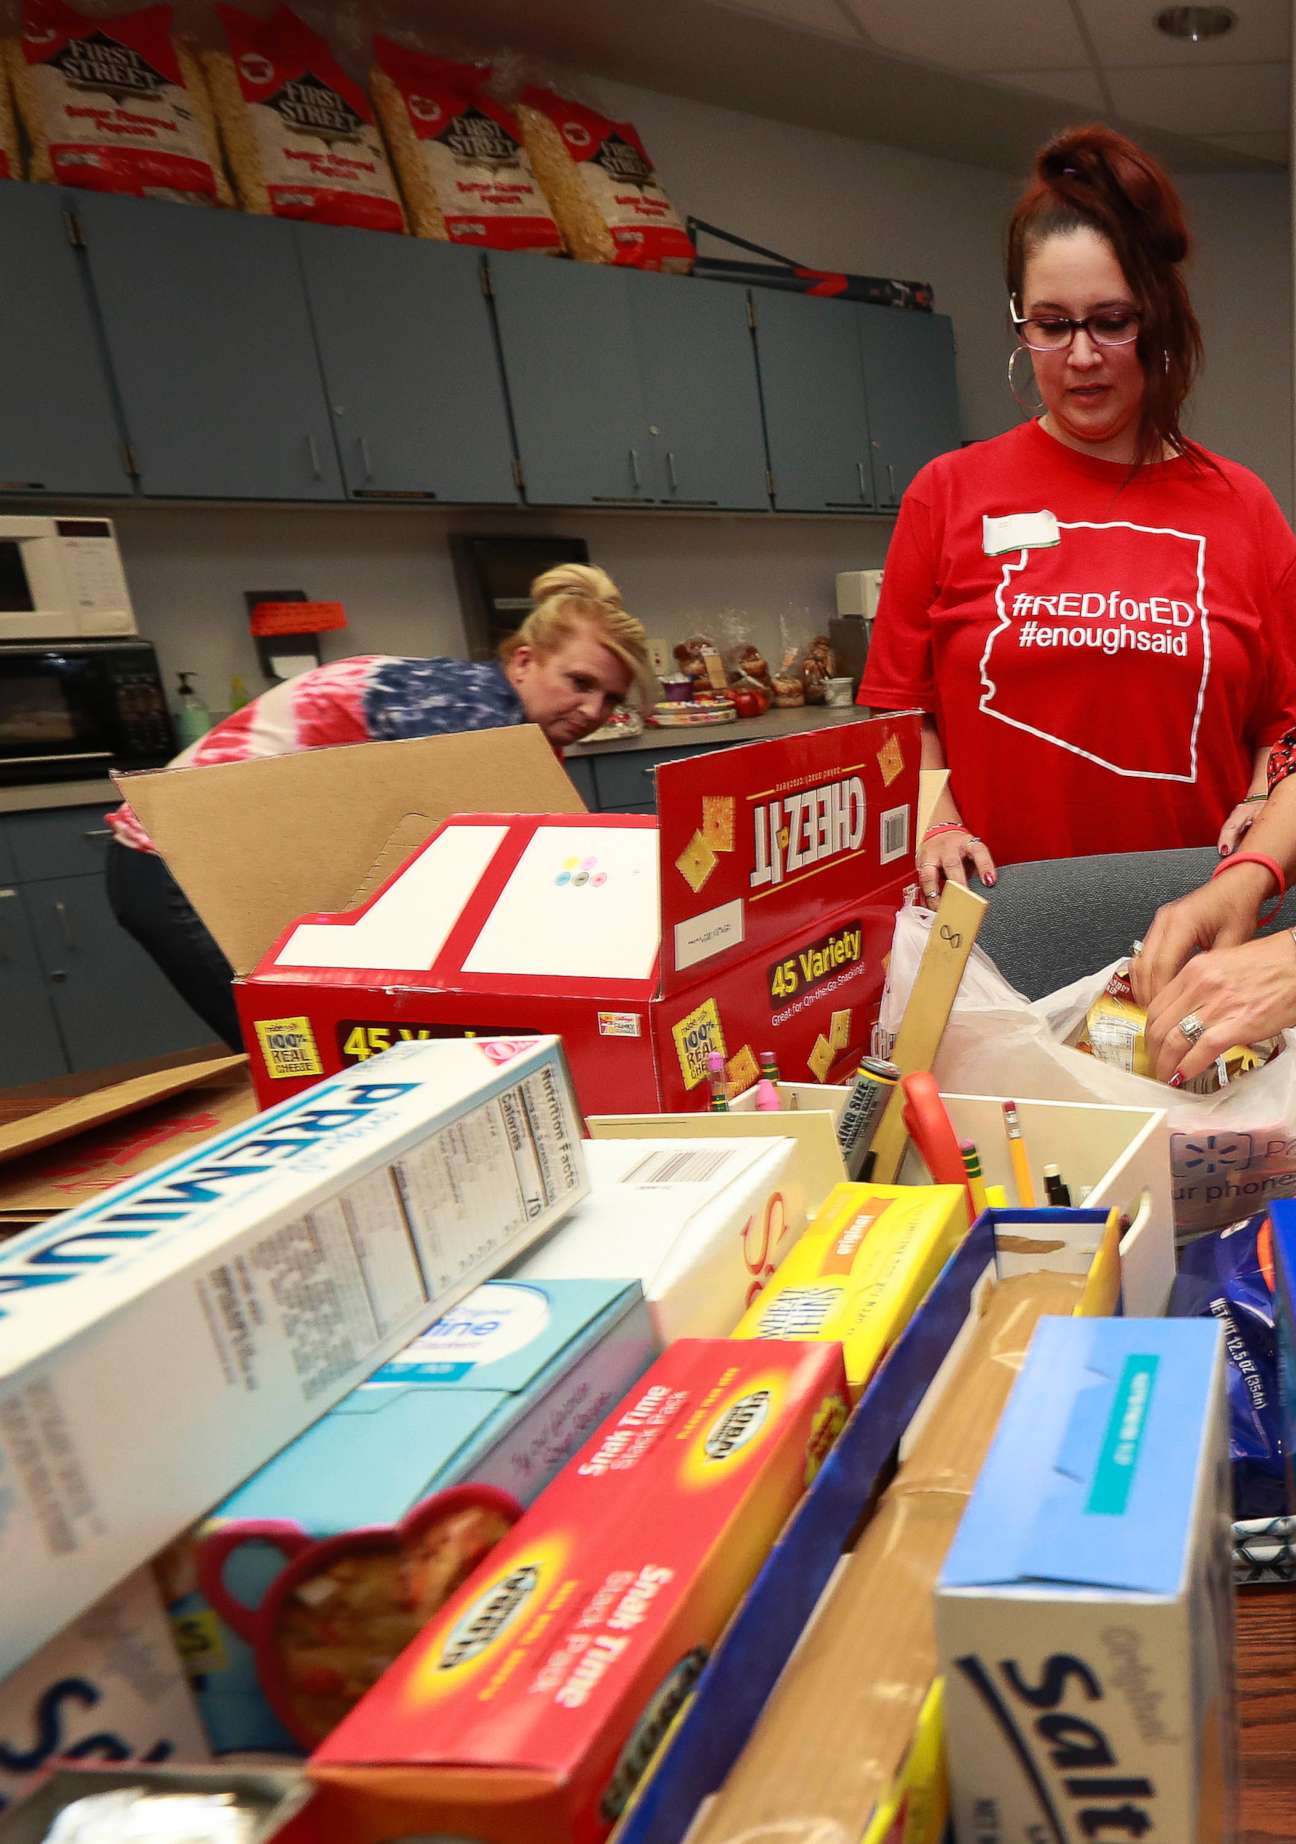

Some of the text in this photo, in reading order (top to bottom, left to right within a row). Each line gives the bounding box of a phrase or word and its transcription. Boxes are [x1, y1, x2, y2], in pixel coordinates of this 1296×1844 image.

[68, 38, 139, 68] FIRST
[61, 57, 159, 91] STREET
[285, 79, 346, 111] FIRST
[278, 99, 358, 135] STREET
[453, 116, 502, 140] FIRST
[448, 134, 515, 159] STREET
[1011, 590, 1196, 628] #REDforED
[1018, 620, 1189, 657] #enoughsaid
[771, 929, 862, 999] 45 Variety
[771, 1007, 792, 1027] Great
[792, 1001, 803, 1015] for
[266, 1033, 308, 1049] 100%
[343, 1027, 392, 1062] 45
[683, 1019, 716, 1054] 100%
[686, 1042, 718, 1066] REAL
[272, 1050, 310, 1063] REAL
[275, 1062, 314, 1074] CHEESE
[849, 1080, 869, 1114] SIZE
[501, 1093, 522, 1151] Calories
[541, 1068, 577, 1190] Nutrition Facts
[836, 1214, 877, 1256] original
[786, 1286, 845, 1335] THINS
[1208, 1297, 1230, 1320] NET
[1226, 1336, 1248, 1362] 12.5
[1237, 1360, 1257, 1375] OZ
[577, 1384, 672, 1477] Snak Time
[554, 1563, 676, 1710] Snak Time
[527, 1633, 594, 1694] Pack
[997, 1652, 1157, 1840] Salt
